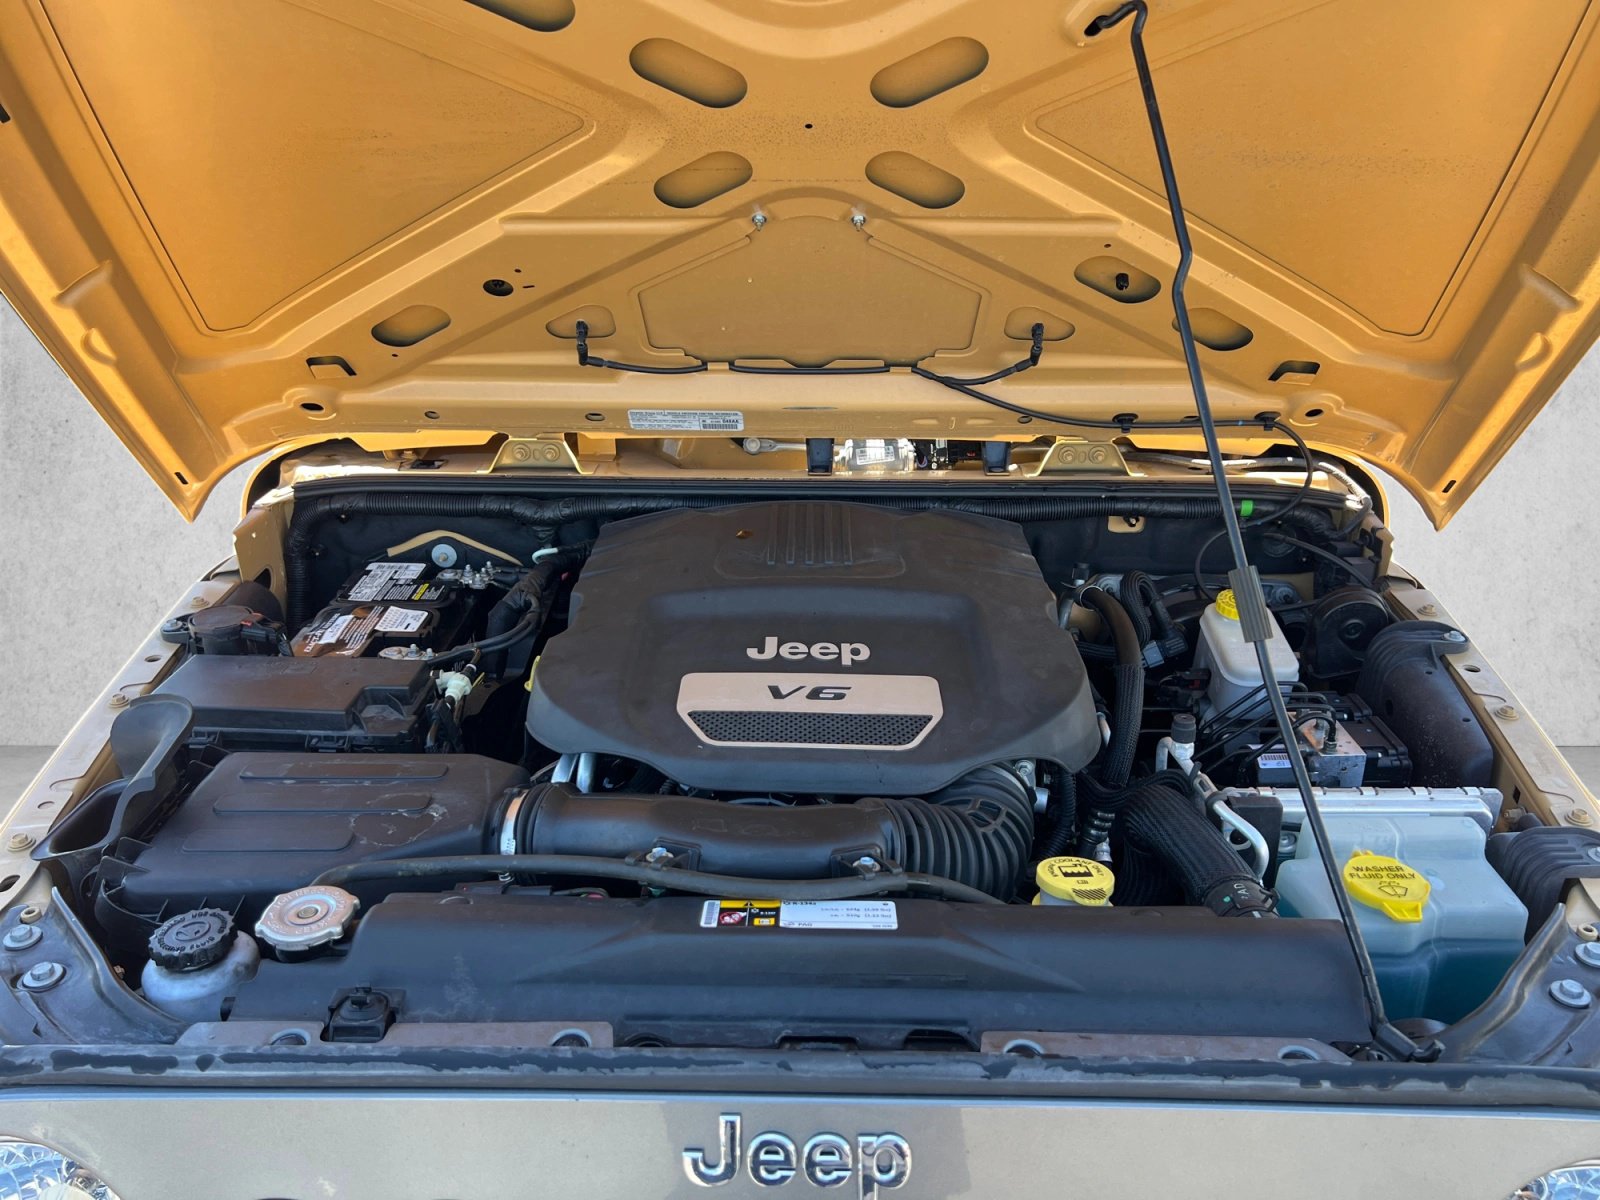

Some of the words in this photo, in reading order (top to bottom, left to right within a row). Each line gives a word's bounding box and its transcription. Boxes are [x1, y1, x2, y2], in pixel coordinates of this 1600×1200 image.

[746, 636, 871, 665] Jeep
[767, 685, 852, 700] V6
[682, 1112, 912, 1200] Jeep
